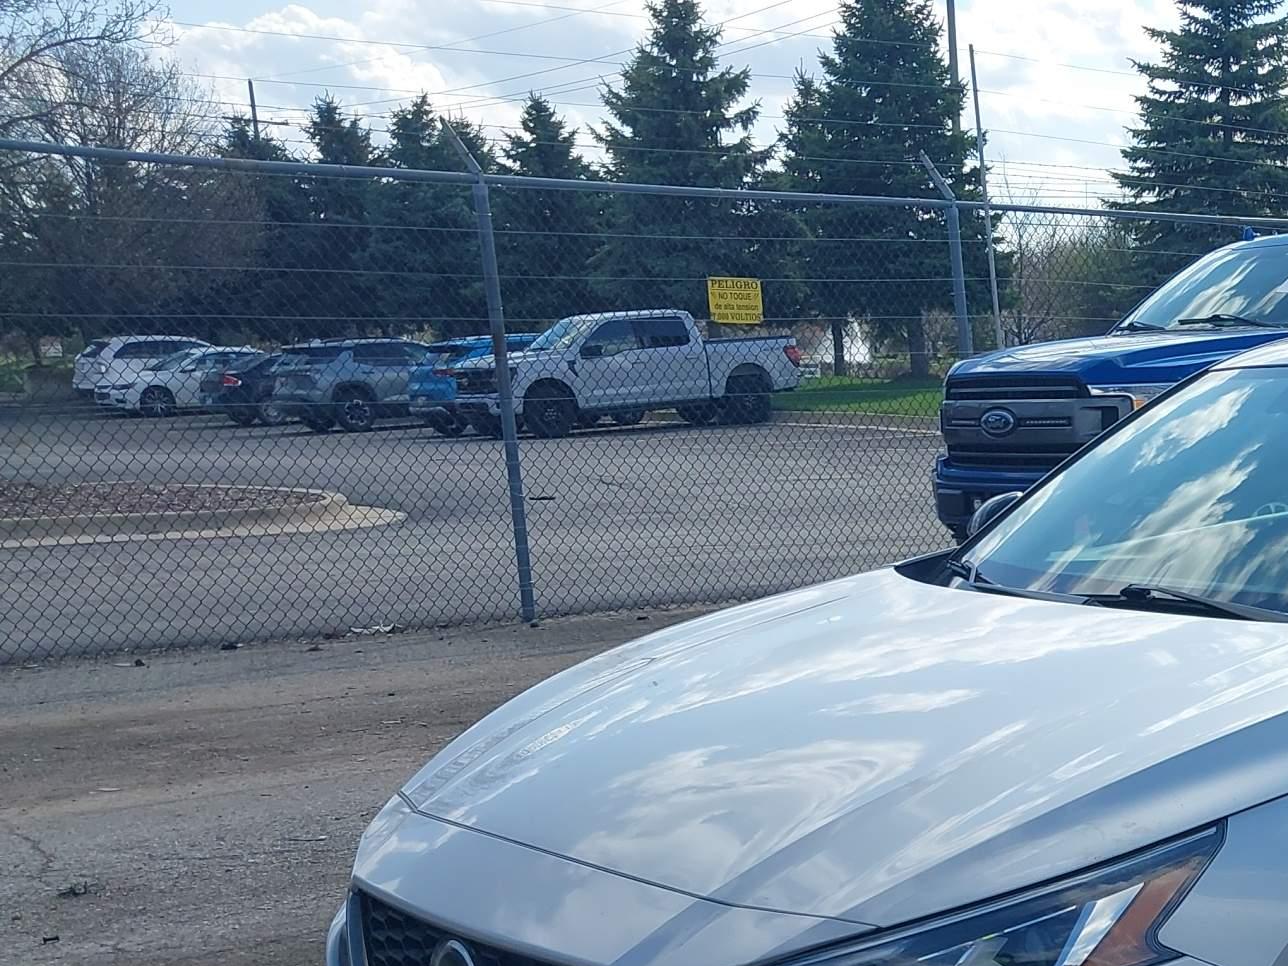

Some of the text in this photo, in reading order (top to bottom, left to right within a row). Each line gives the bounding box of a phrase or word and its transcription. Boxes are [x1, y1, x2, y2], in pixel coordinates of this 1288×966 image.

[711, 279, 759, 290] PELIGRO
[718, 291, 753, 301] NO TOQUE
[714, 302, 723, 310] de
[724, 302, 735, 311] alta
[730, 312, 762, 322] VOLTIOS
